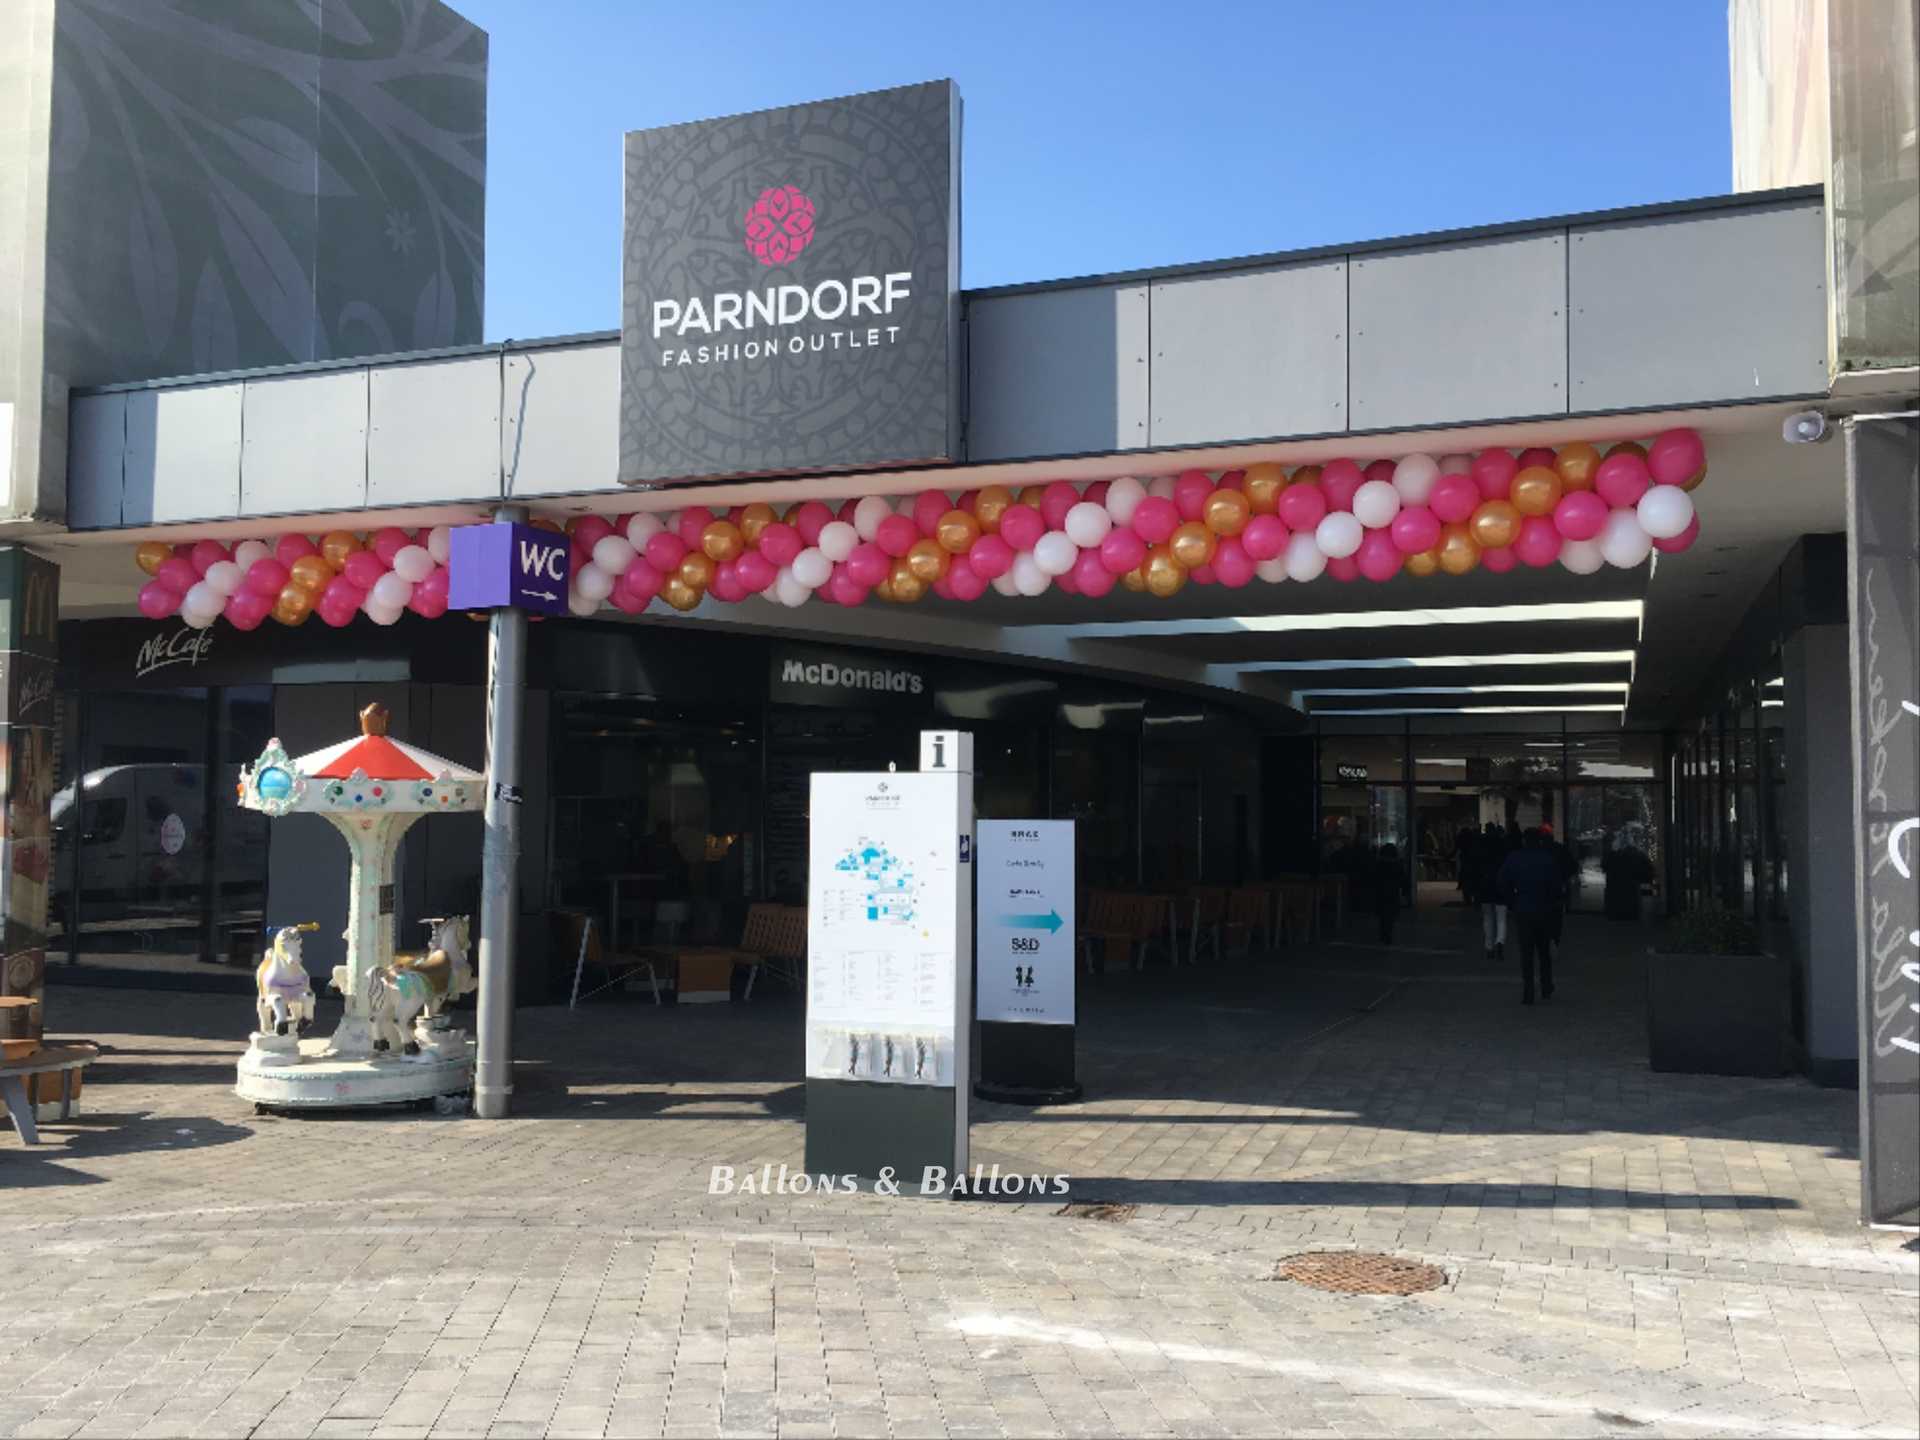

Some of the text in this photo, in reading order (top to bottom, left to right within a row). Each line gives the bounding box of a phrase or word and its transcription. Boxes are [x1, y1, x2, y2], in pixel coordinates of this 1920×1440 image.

[653, 272, 912, 339] PARNDORF
[662, 326, 901, 366] FASHION OUTLET
[520, 540, 565, 581] WC
[782, 660, 924, 694] McDonald's
[932, 735, 946, 768] i
[1011, 937, 1040, 951] S&D
